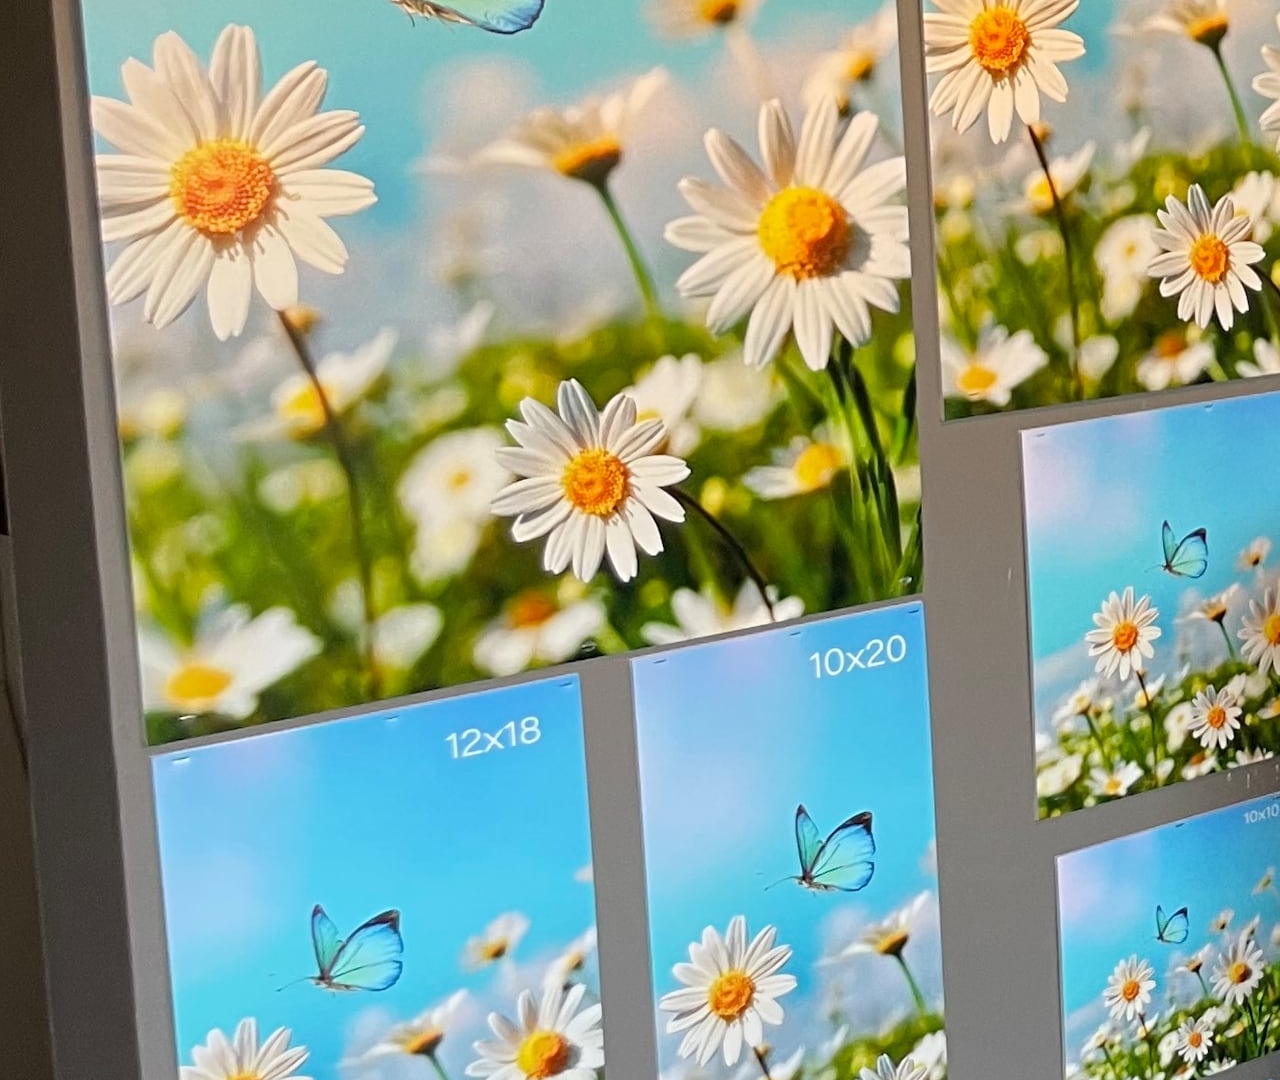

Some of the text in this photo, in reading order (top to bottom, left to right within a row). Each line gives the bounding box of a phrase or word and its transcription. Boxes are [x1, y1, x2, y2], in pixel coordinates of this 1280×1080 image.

[809, 634, 906, 679] 10x20
[445, 716, 541, 759] 12x18
[1243, 803, 1280, 825] 10x10
